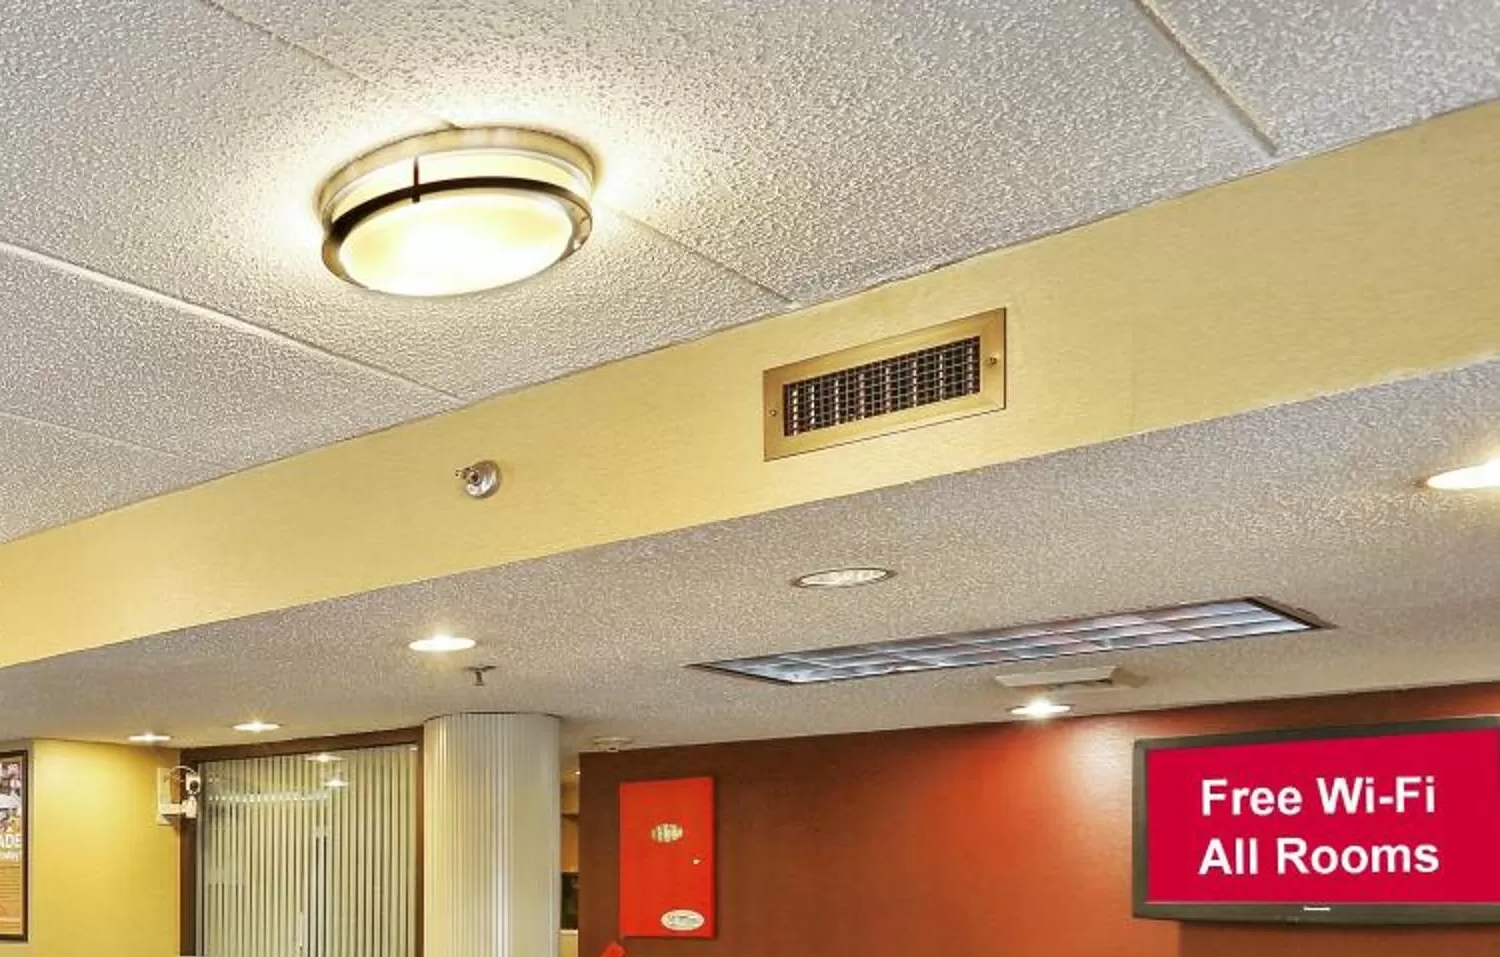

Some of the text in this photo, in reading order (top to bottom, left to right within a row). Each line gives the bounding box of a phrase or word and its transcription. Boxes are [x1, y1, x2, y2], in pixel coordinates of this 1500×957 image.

[1202, 776, 1436, 816] Free Wi-Fi
[1199, 837, 1439, 875] All Rooms
